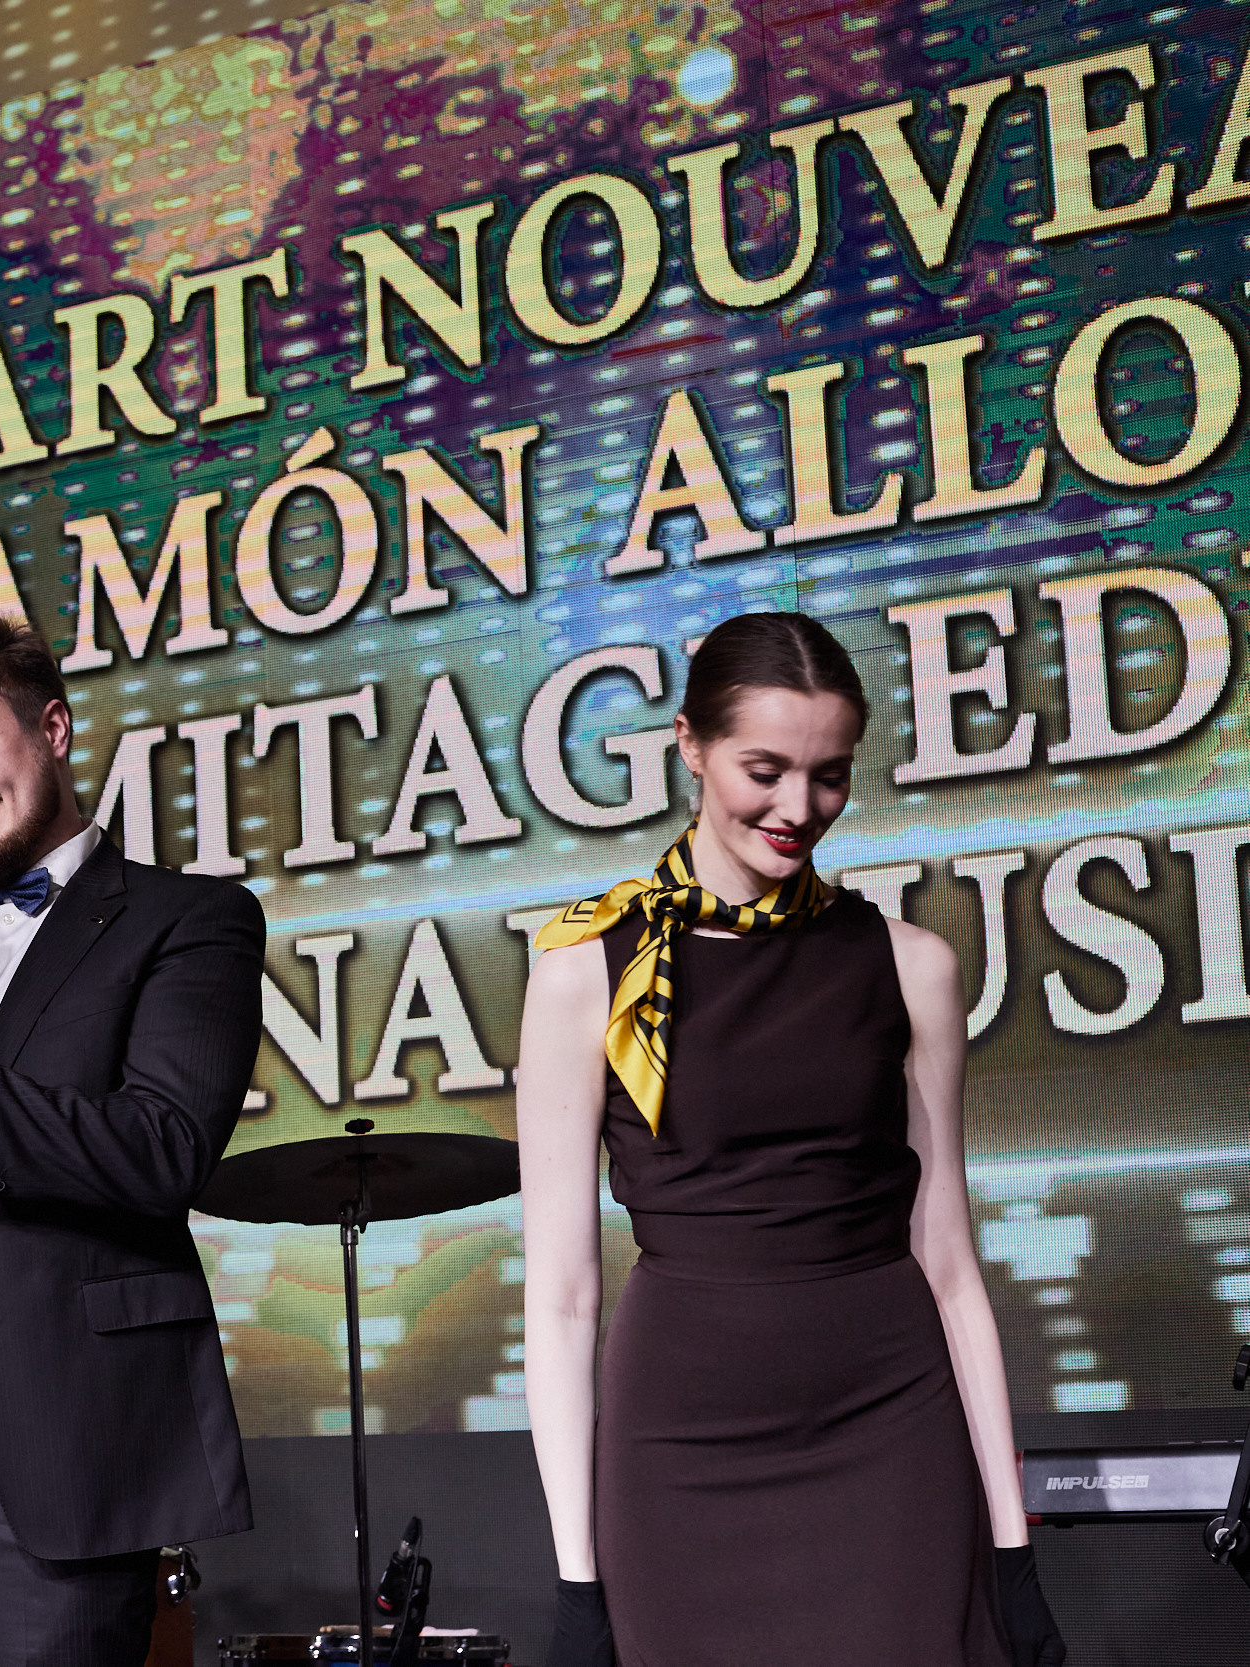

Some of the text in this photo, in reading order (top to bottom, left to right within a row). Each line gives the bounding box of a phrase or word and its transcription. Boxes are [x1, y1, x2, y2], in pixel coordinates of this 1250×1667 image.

[606, 280, 1250, 579] ALLO
[888, 554, 1250, 785] ED
[1046, 1475, 1135, 1491] IMPULSE
